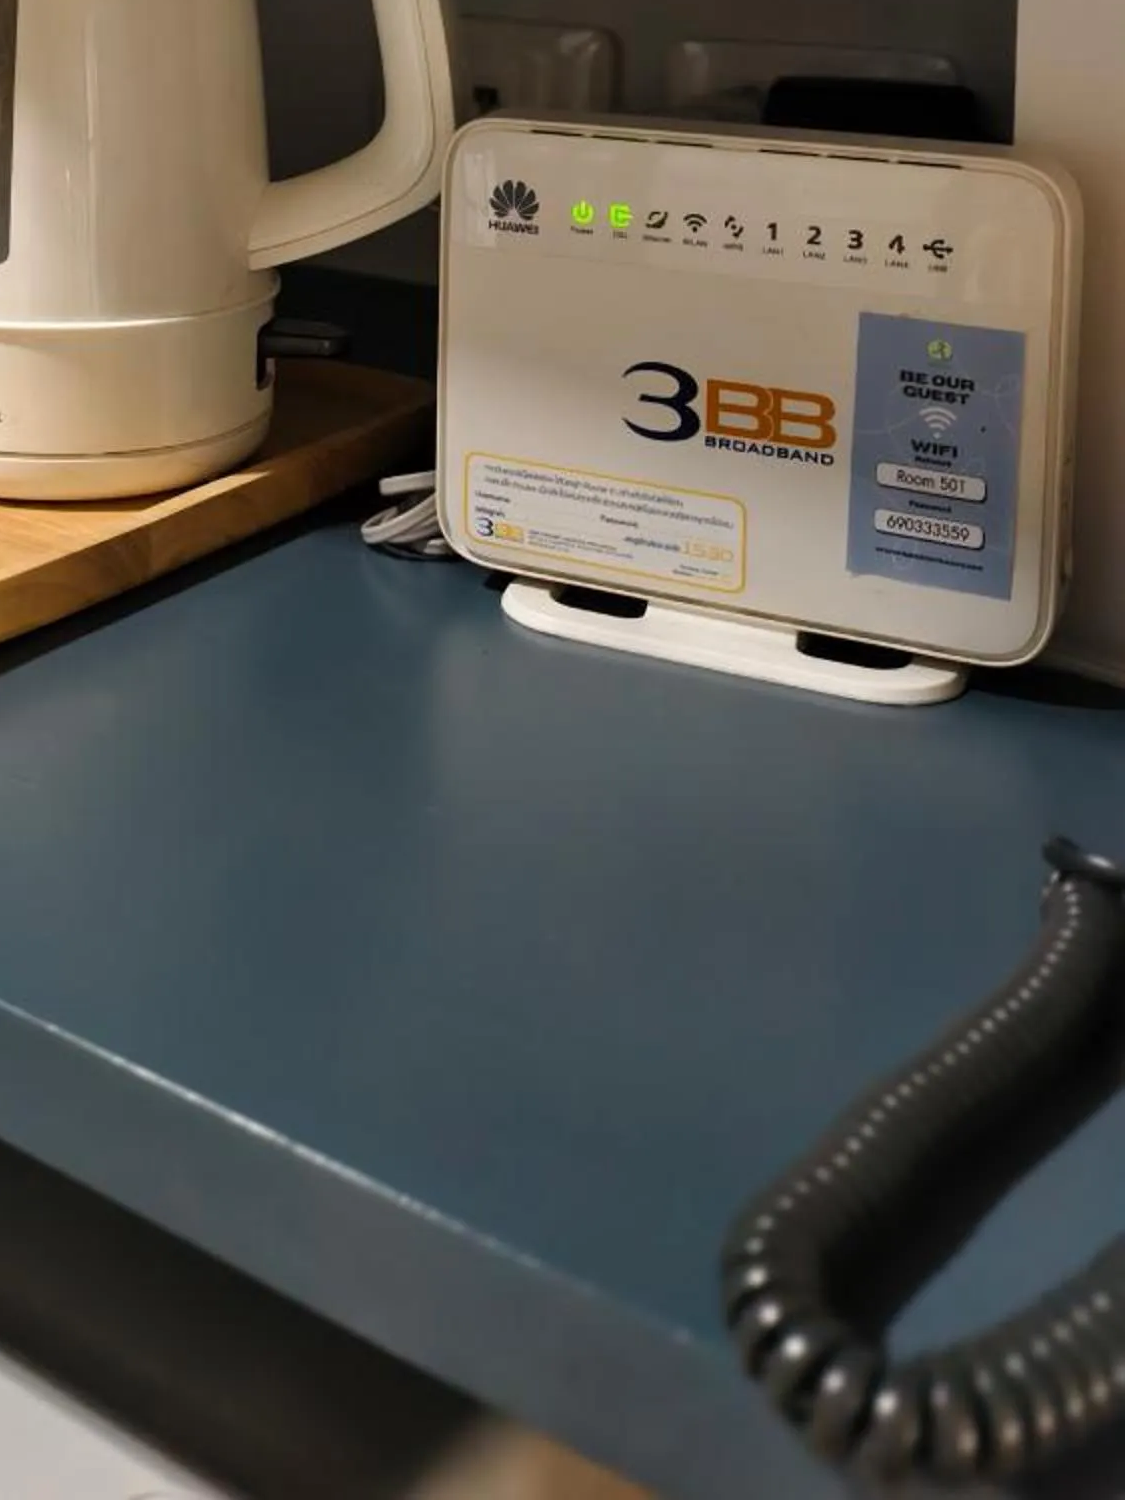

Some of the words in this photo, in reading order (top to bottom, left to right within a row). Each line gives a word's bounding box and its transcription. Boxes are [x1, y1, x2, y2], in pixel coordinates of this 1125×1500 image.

[488, 219, 539, 236] HUAWEI
[766, 222, 778, 241] 1
[806, 226, 822, 246] 2
[847, 230, 864, 250] 3
[888, 234, 906, 254] 4
[900, 369, 928, 385] BE
[931, 374, 975, 392] OUR
[621, 361, 837, 449] 3BB
[903, 385, 970, 405] GUEST
[704, 435, 835, 467] BROADBAND
[911, 438, 959, 458] WIFI
[896, 469, 935, 489] Room
[939, 475, 966, 494] 501
[886, 514, 971, 542] 690333559
